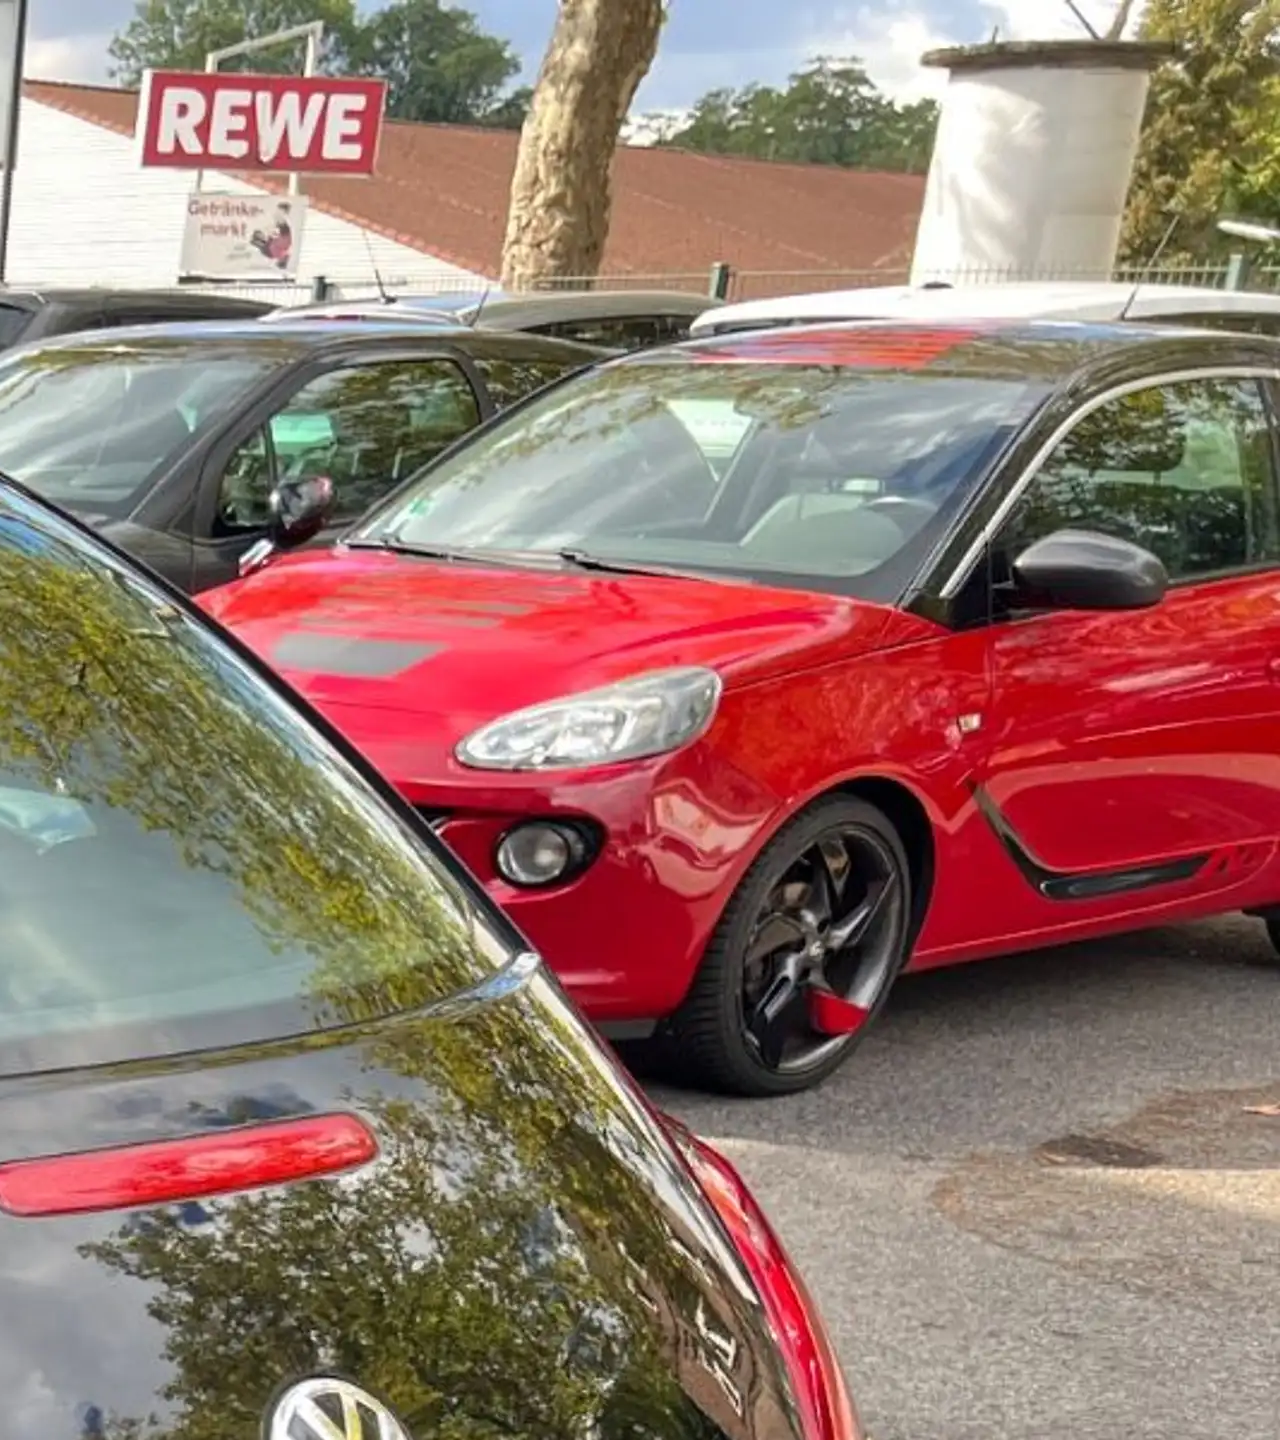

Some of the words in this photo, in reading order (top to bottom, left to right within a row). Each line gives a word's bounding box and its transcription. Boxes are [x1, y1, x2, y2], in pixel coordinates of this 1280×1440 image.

[156, 87, 367, 162] REWE
[188, 200, 264, 217] Getränke-
[200, 222, 247, 239] markt
